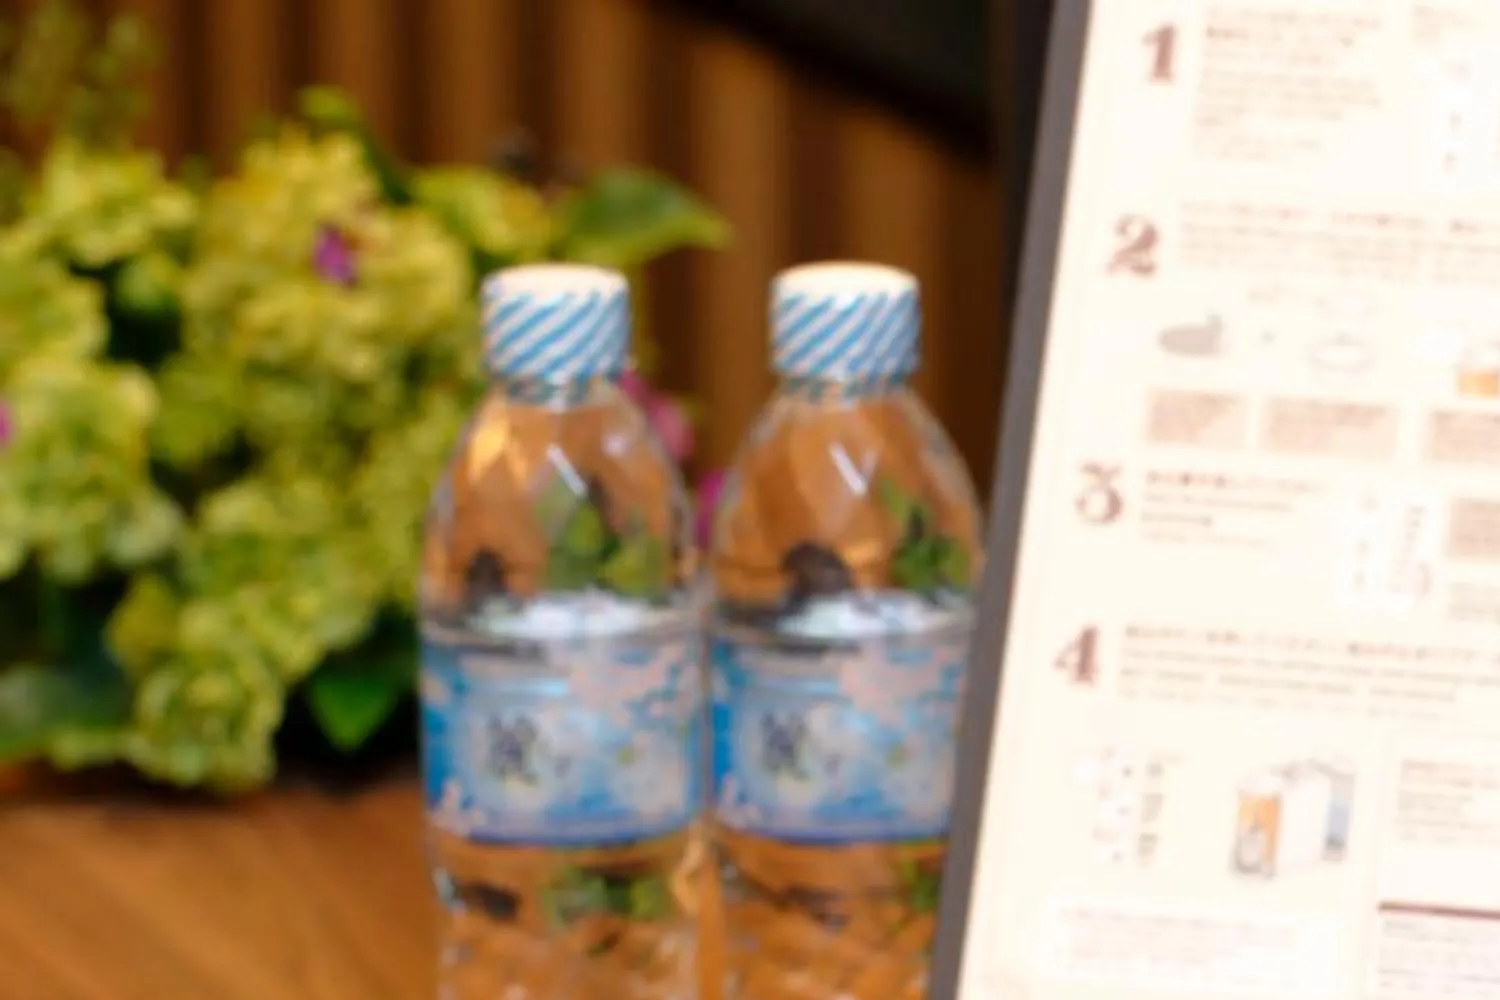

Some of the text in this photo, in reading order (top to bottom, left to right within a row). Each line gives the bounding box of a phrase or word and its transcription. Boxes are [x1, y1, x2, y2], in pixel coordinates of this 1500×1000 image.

[1143, 25, 1178, 83] 1
[1107, 214, 1159, 277] 2
[1055, 624, 1102, 687] 4
